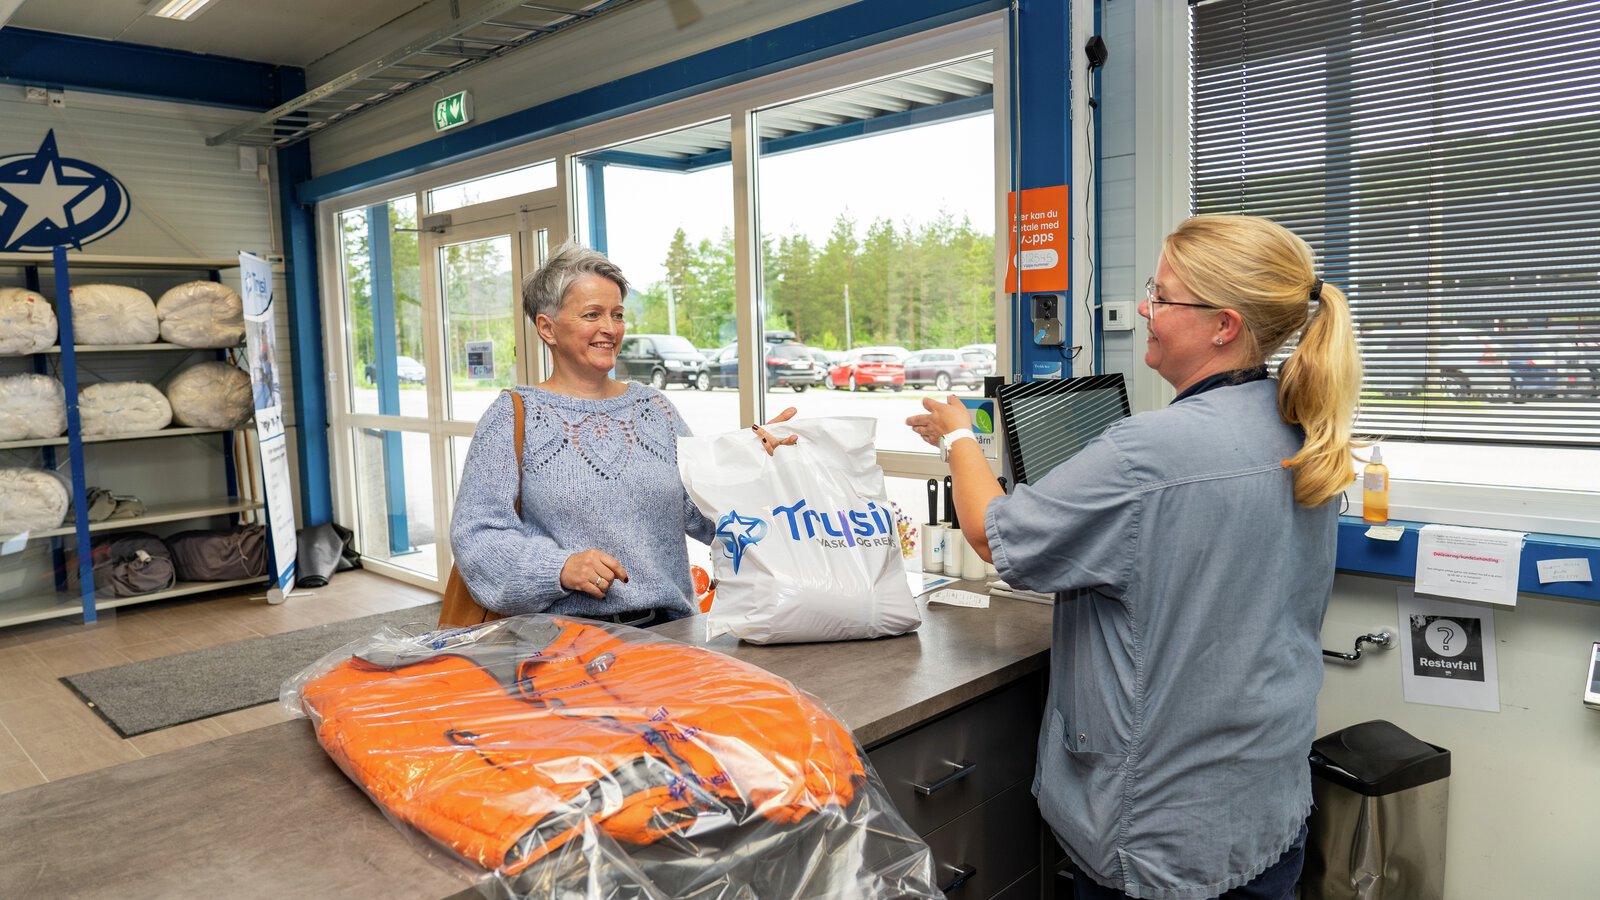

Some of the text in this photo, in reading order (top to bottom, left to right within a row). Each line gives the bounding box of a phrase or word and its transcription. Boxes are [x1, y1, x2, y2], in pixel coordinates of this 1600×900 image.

[1030, 211, 1045, 220] kan
[1047, 209, 1058, 218] du
[1040, 221, 1060, 230] med
[772, 498, 893, 548] Trysil
[816, 537, 847, 549] VASK
[857, 537, 872, 548] OG
[1420, 657, 1477, 671] Restavfall
